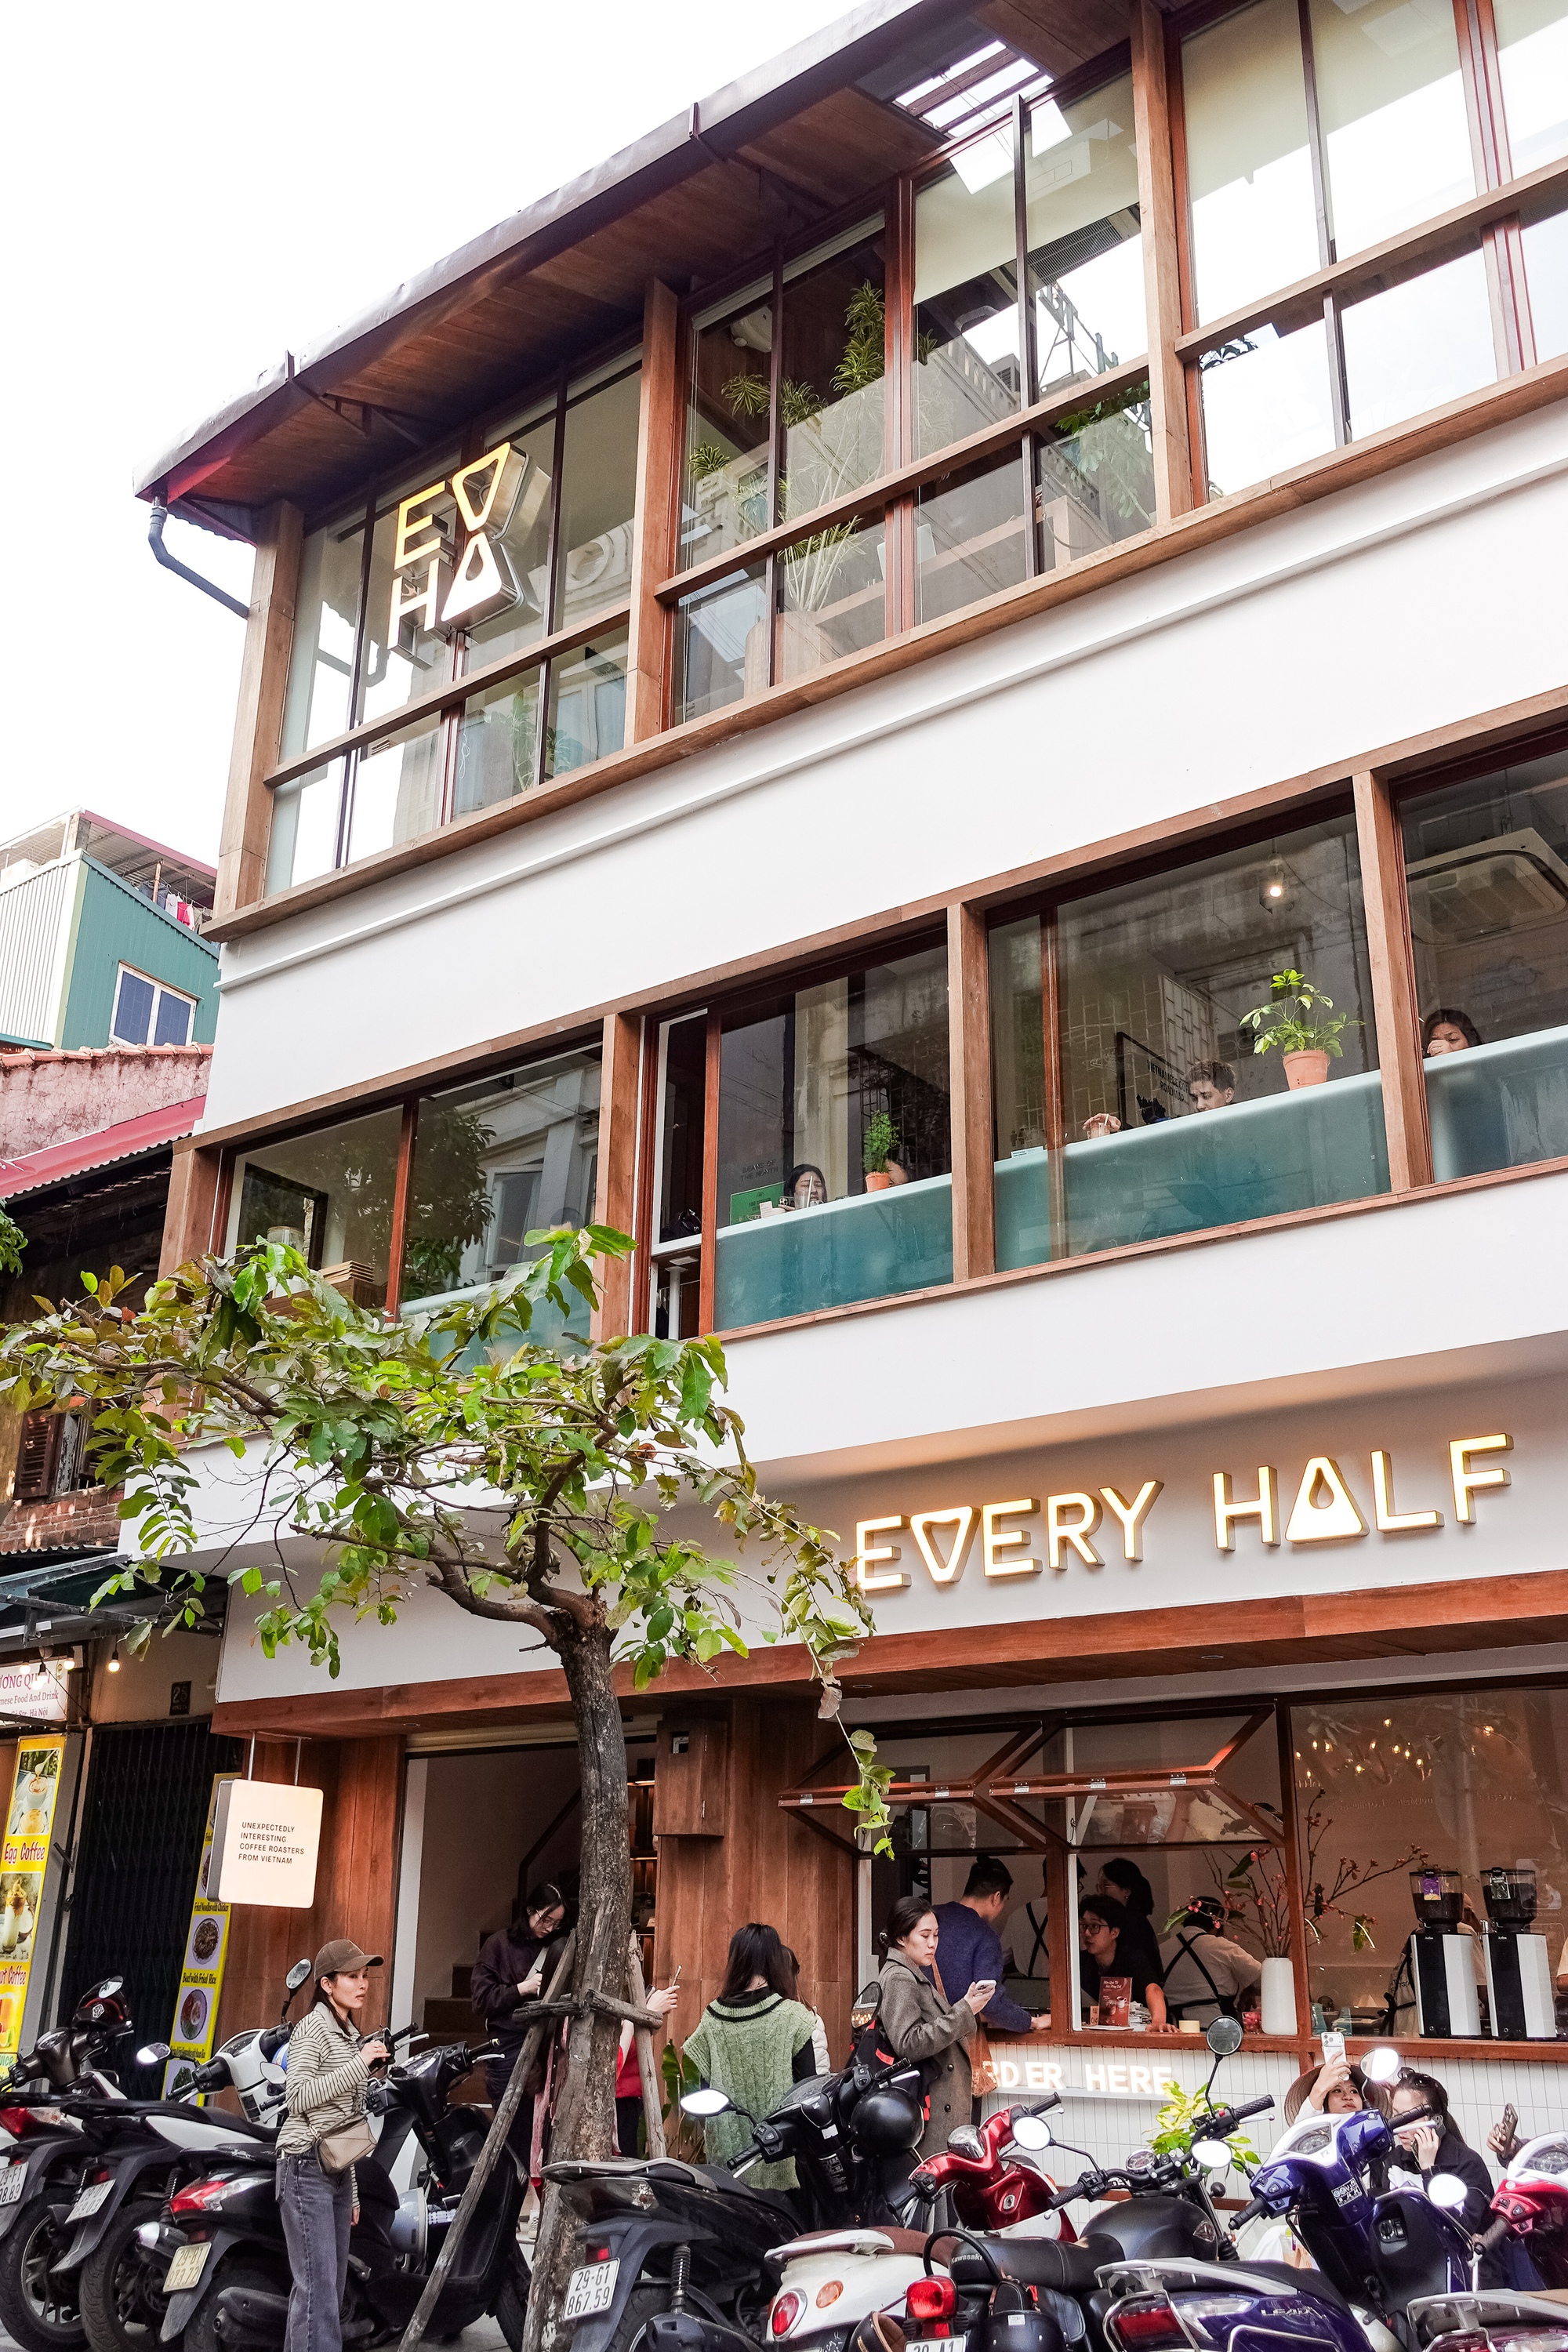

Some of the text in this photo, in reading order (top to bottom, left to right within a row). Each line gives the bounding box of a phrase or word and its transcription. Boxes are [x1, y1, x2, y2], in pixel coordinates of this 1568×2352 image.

[855, 1432, 1514, 1591] EVERY HALF
[14, 1693, 28, 1704] Food
[29, 1691, 41, 1702] And
[42, 1690, 59, 1700] Drink
[38, 1707, 49, 1718] Nội
[241, 1821, 295, 1832] UNEXPECTEDLY
[240, 1832, 287, 1842] INTERESTING
[4, 1842, 45, 1864] Egg Coffee
[239, 1842, 305, 1855] COFFEE ROASTERS
[238, 1853, 292, 1864] FROM VIETNAM
[8, 1965, 27, 1985] Coffee
[183, 1972, 191, 1983] Beef
[198, 1973, 209, 1984] Fried
[209, 1973, 217, 1984] Rice
[1085, 2063, 1172, 2094] HERE
[176, 2247, 204, 2267] 29-B1
[951, 2253, 983, 2264] Kawasaki
[575, 2263, 611, 2291] 29-G1
[567, 2286, 611, 2316] 867.59
